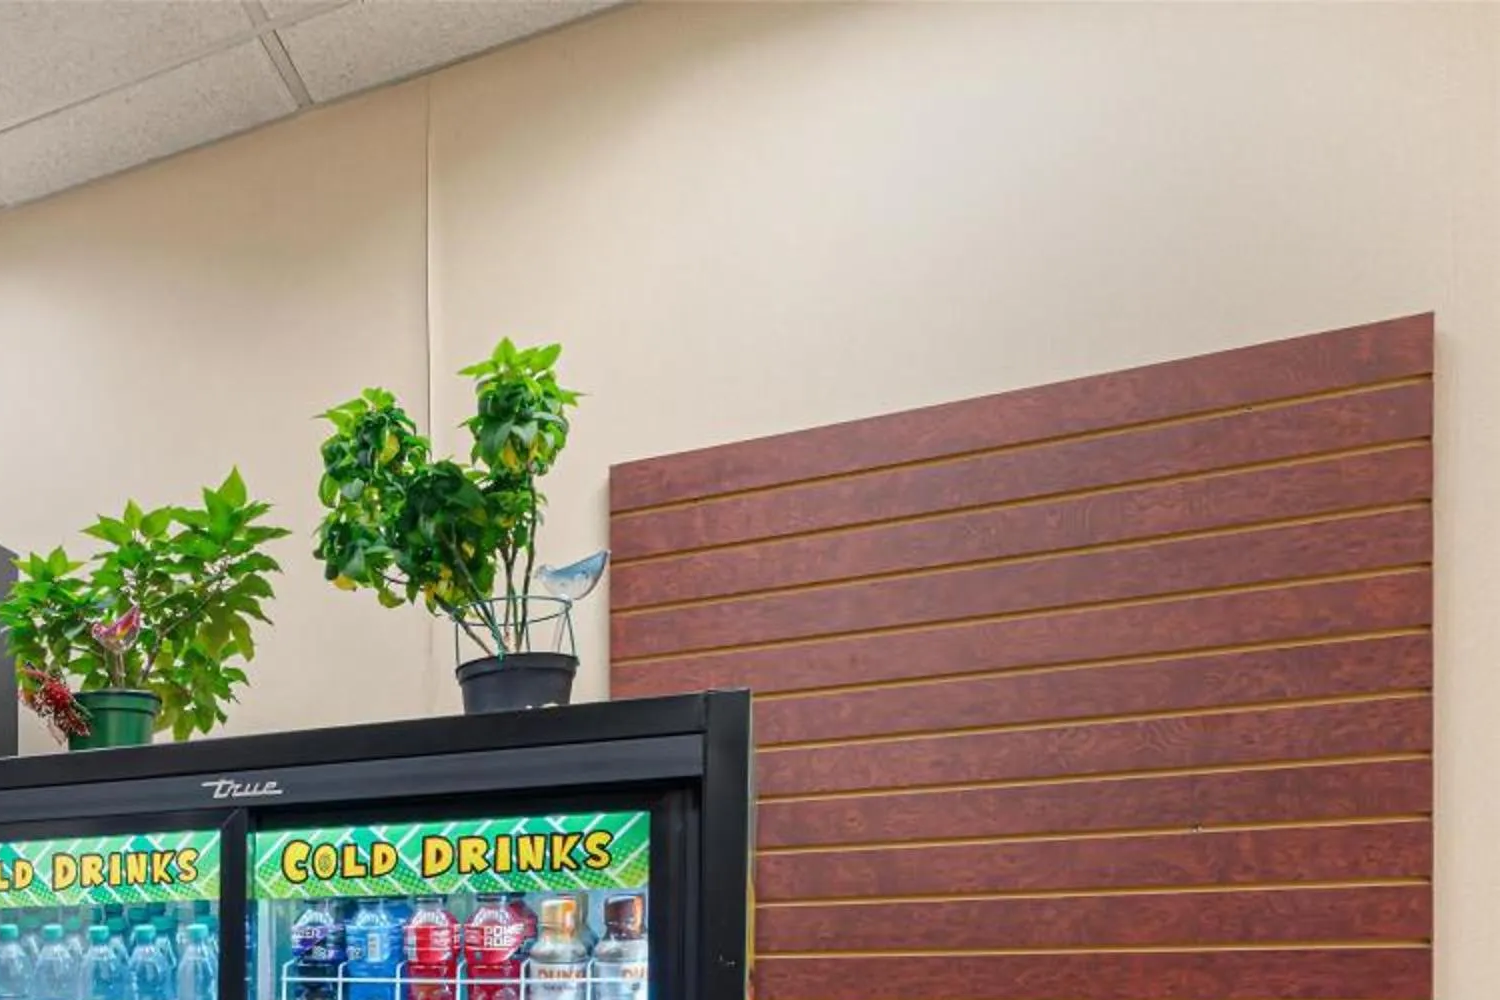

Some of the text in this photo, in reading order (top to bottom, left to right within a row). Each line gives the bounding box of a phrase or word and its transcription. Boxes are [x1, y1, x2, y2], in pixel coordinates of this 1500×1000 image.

[201, 779, 283, 799] True
[52, 847, 200, 891] DRINKS
[281, 830, 614, 884] COLD DRINKS
